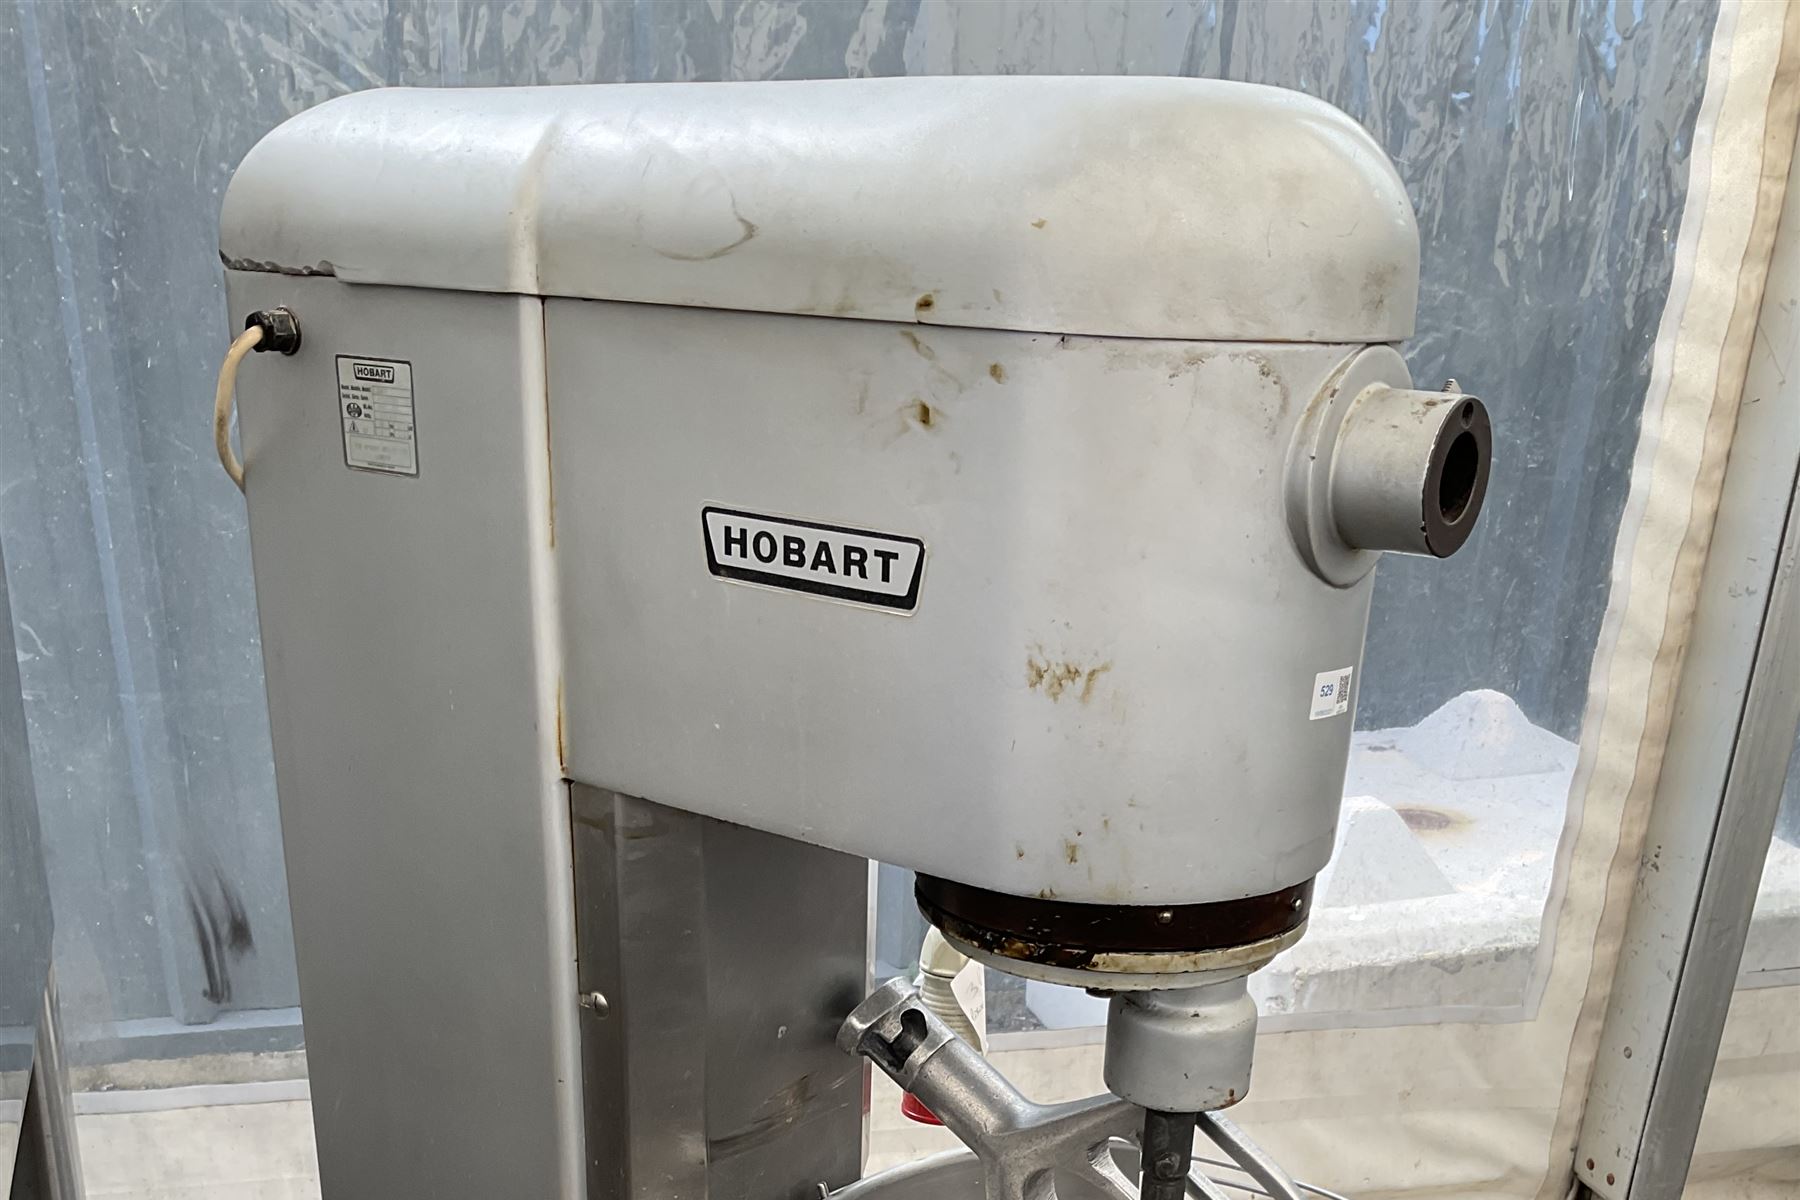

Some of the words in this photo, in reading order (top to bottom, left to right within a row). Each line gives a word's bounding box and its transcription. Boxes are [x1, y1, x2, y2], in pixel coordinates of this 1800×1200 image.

[356, 366, 392, 379] HOBART
[724, 525, 899, 583] HOBART
[1320, 683, 1334, 697] 529
